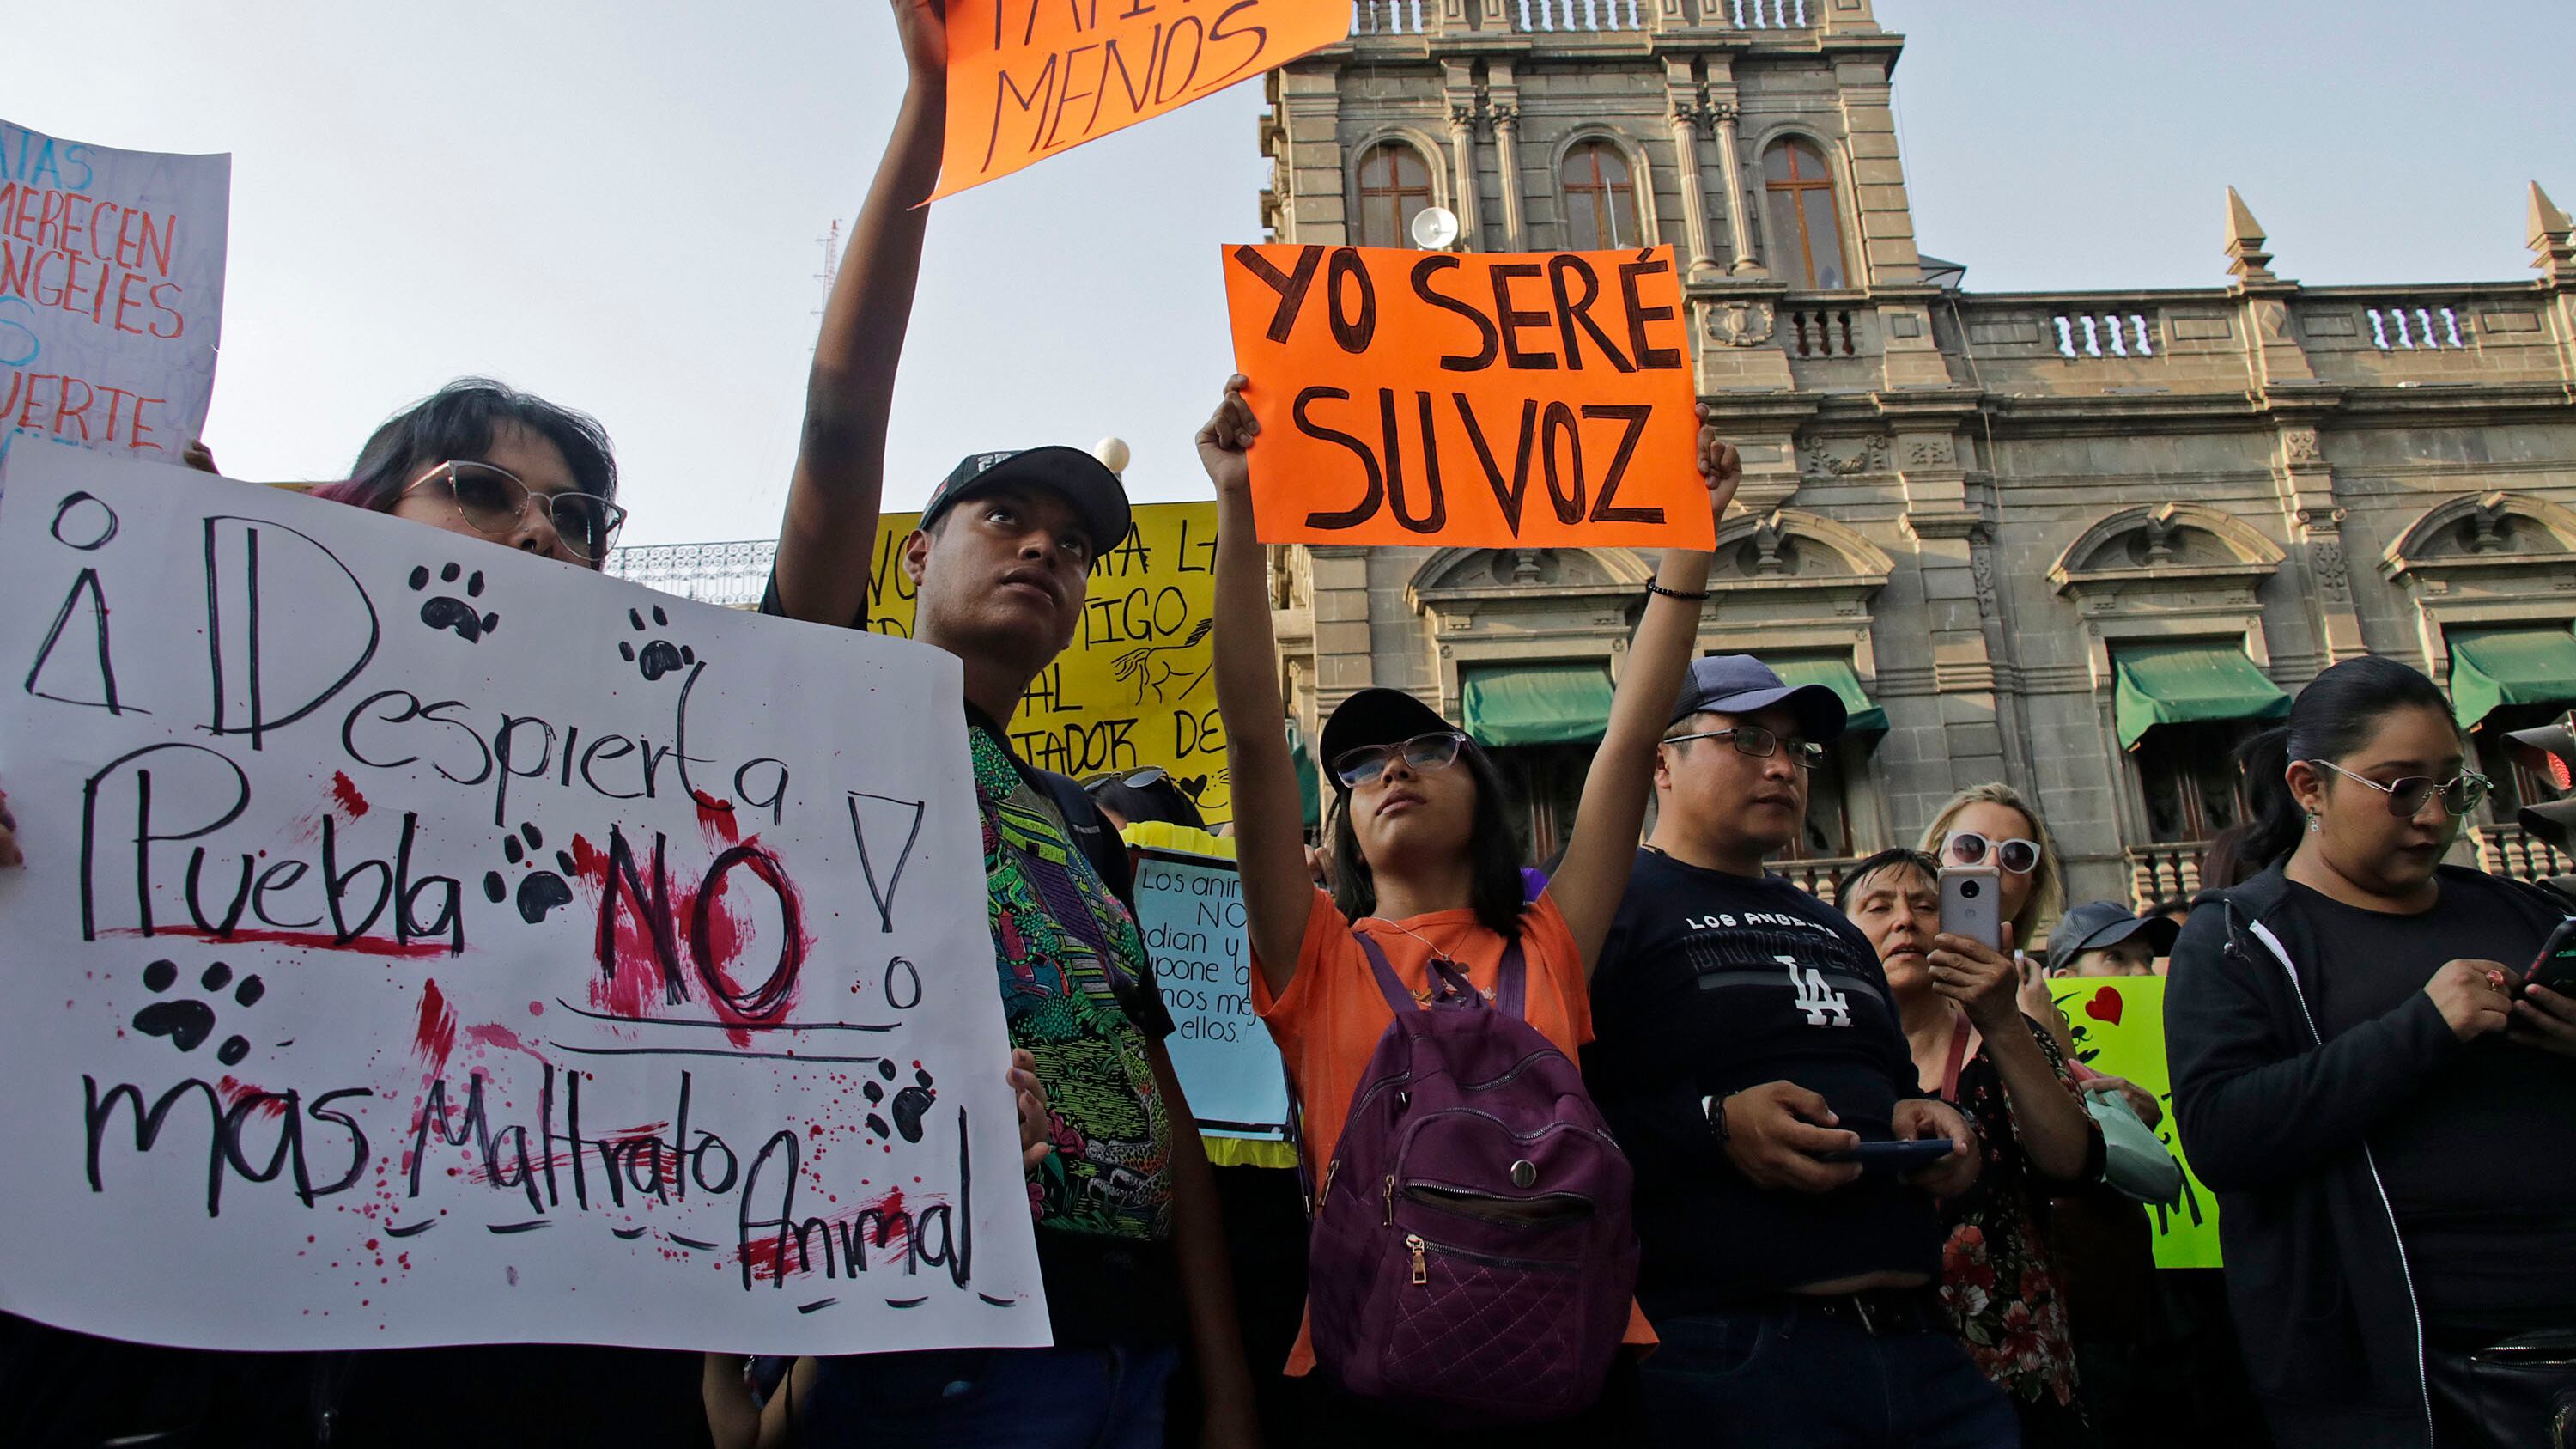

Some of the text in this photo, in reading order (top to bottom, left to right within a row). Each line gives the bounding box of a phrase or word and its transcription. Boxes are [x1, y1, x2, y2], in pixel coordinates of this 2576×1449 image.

[980, 0, 1267, 174] MENOS
[1234, 245, 1682, 374] YO SERÉ
[81, 742, 465, 959] Puebla
[598, 822, 802, 1020] NO
[1142, 868, 1185, 893] Los
[1197, 901, 1248, 928] NO
[1686, 913, 1737, 930] LOS
[1225, 937, 1239, 971] y
[1773, 955, 1851, 1027] LA
[1181, 1016, 1240, 1043] ellos.
[408, 1062, 738, 1215] Maltrato
[738, 1105, 971, 1291] Animal
